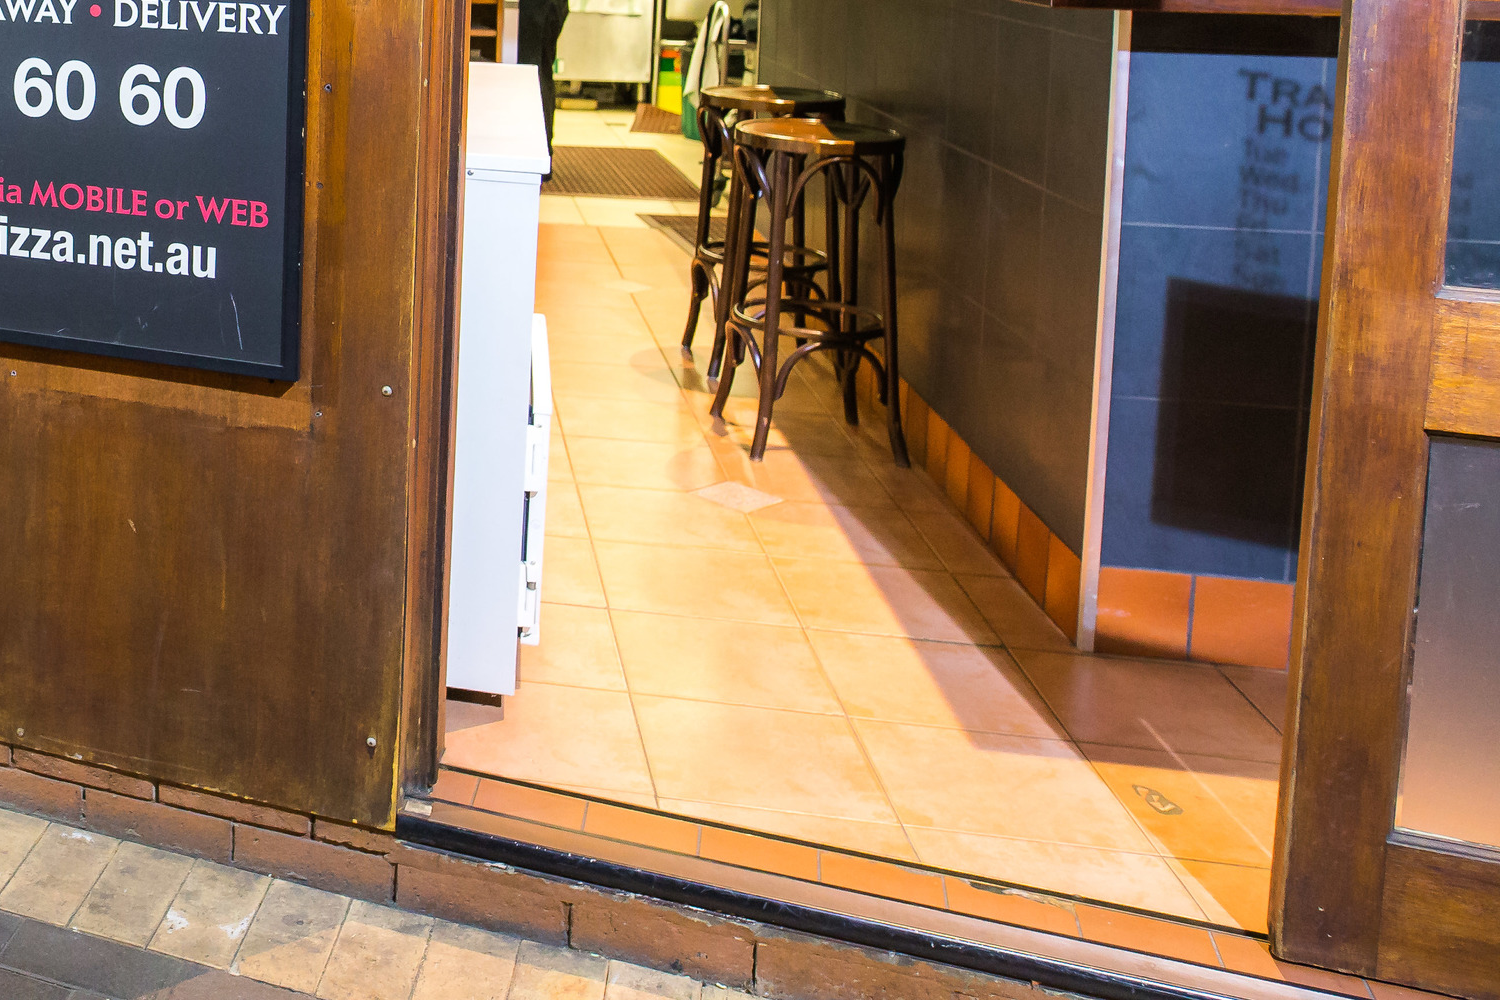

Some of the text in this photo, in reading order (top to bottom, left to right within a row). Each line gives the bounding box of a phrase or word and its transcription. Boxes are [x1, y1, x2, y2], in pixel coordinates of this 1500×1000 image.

[13, 57, 96, 122] 60
[119, 63, 206, 129] 60
[29, 181, 147, 216] MOBILE
[155, 196, 189, 220] or
[196, 195, 270, 228] WEB
